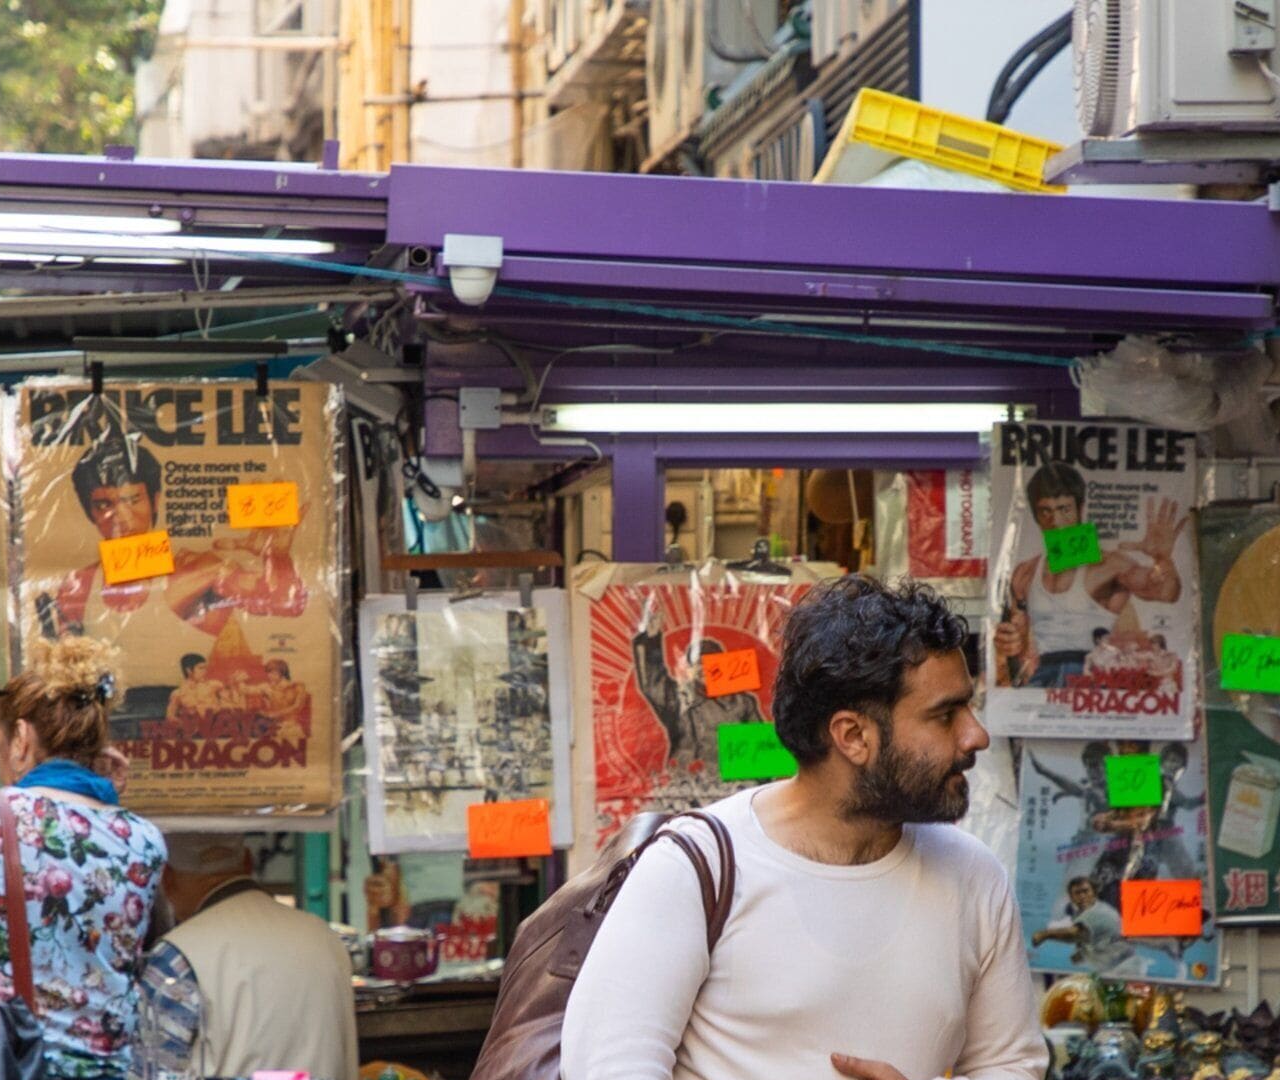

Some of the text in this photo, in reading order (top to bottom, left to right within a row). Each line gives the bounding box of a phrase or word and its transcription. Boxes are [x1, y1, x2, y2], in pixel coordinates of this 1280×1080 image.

[29, 388, 302, 447] BRUCE LEE
[999, 424, 1186, 472] BRUCE LEE
[165, 460, 267, 474] Once more the
[165, 474, 239, 486] Colosseum
[1142, 482, 1159, 492] the
[165, 486, 228, 499] echoes th
[166, 499, 223, 511] sound of
[166, 512, 229, 525] fight to th
[960, 469, 974, 556] HOTOGRAPH
[167, 525, 212, 538] death!
[1046, 688, 1181, 715] THE DRAGON
[151, 737, 308, 770] DRAGON
[1131, 887, 1169, 921] NO
